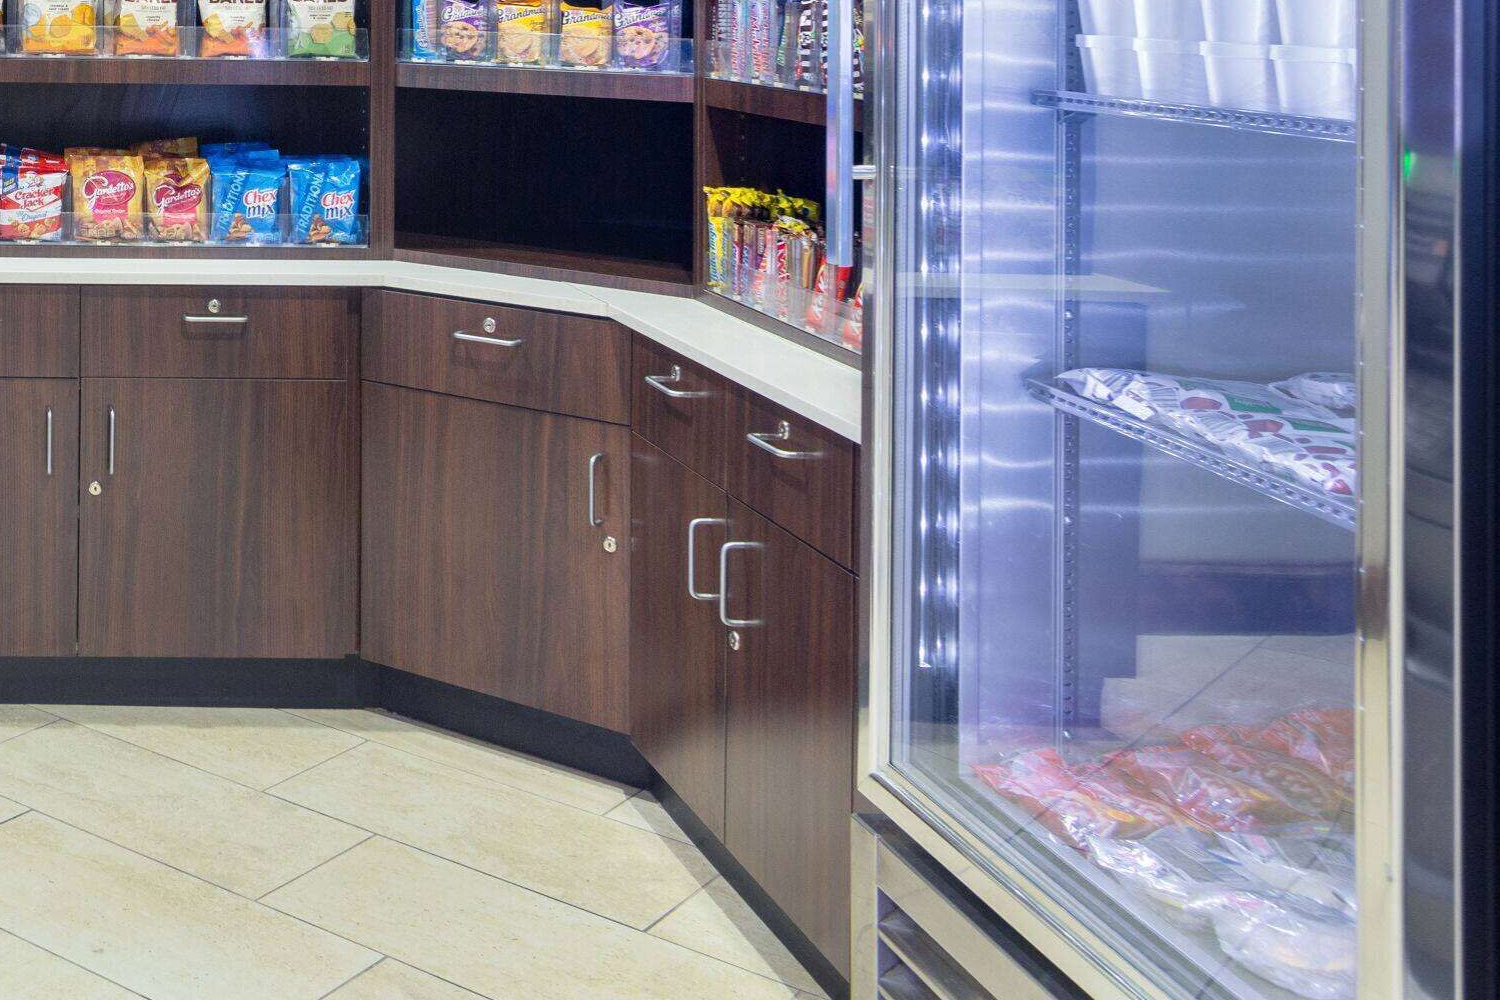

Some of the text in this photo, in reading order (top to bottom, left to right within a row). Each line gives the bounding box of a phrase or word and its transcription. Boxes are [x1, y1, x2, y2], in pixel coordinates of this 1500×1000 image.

[15, 188, 54, 200] Cracker
[83, 175, 134, 210] Gardetto's
[153, 184, 201, 216] Gardetto's
[243, 189, 277, 205] Chex
[322, 191, 354, 208] Chex
[20, 199, 45, 209] Jack
